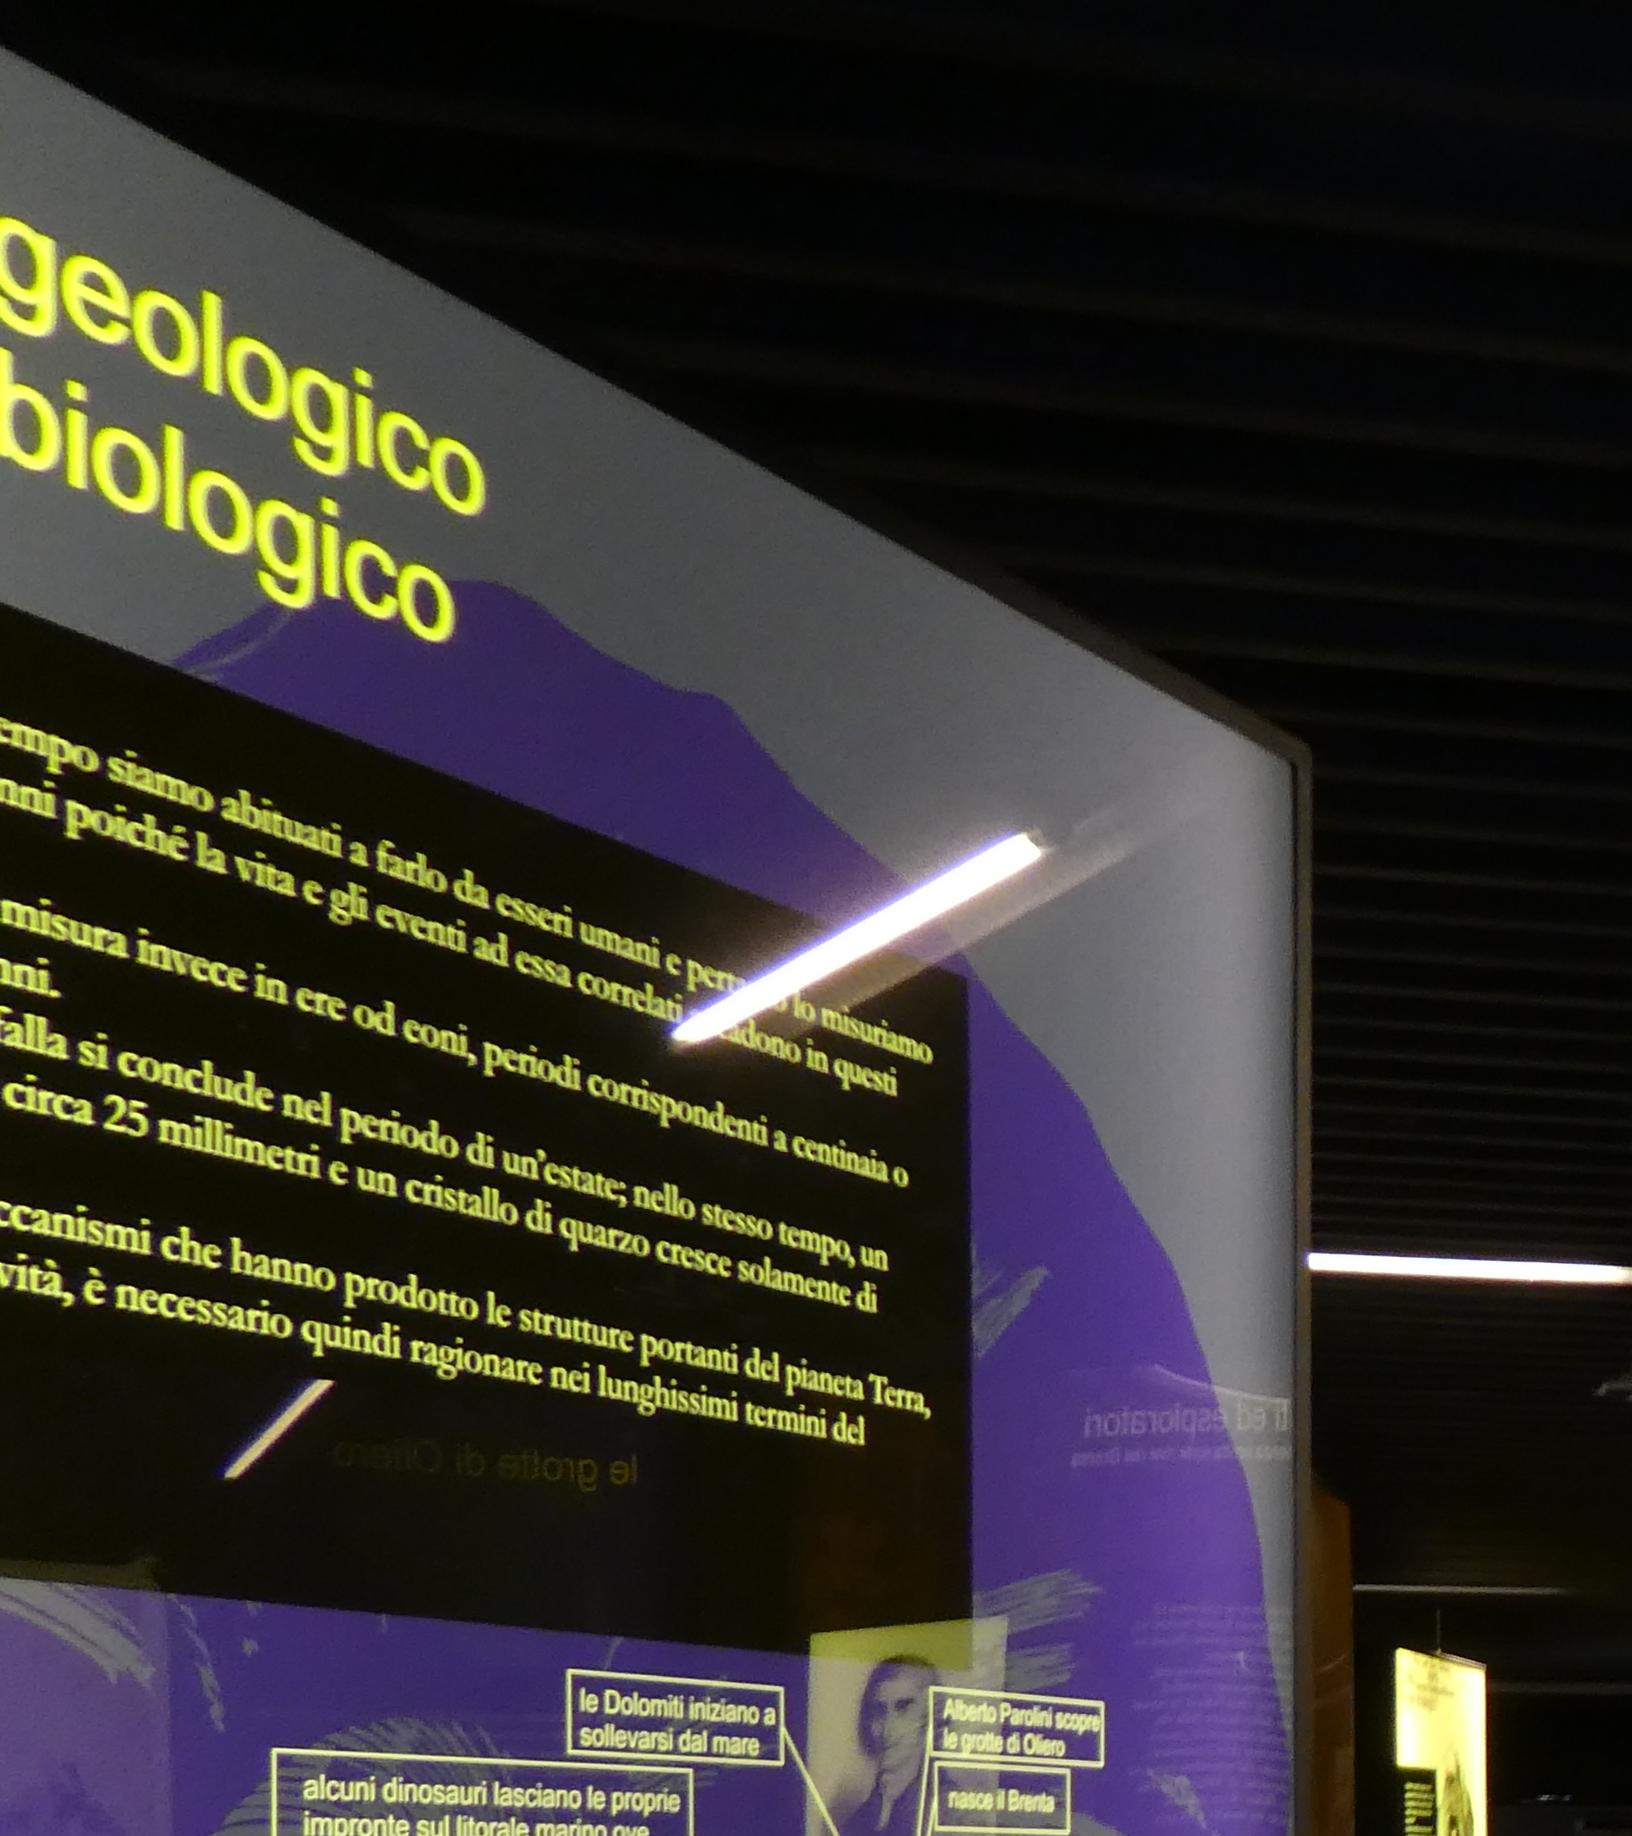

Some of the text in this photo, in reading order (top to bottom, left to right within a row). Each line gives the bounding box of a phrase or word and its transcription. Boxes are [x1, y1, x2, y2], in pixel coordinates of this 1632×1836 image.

[0, 216, 486, 516] geologico
[0, 347, 455, 643] biologico
[0, 897, 910, 1188] misura invece in ere od eoni, periodi corrispondenti a centinaia o
[77, 1032, 109, 1071] si
[116, 1051, 275, 1112] conclude
[281, 1090, 333, 1127] nel
[339, 1107, 461, 1159] periodo
[465, 1131, 495, 1169] di
[632, 1182, 697, 1220] nello
[701, 1203, 774, 1241] stesso
[778, 1221, 857, 1269] tempo,
[859, 1245, 889, 1272] un
[114, 1284, 294, 1339] necessario
[299, 1314, 402, 1360] quindi
[409, 1336, 544, 1386] ragionare
[549, 1361, 591, 1395] nei
[597, 1364, 739, 1422] lunghissimi
[744, 1401, 828, 1439] termini
[830, 1411, 866, 1446] del
[159, 1225, 932, 1420] che hanno prodotto le strutture portanti del pianeta Terra,
[579, 1687, 776, 1726] le Dolomiti iniziano a
[579, 1722, 760, 1758] sollevarsi dal mare
[943, 1698, 1101, 1735] Alberto Parolini scopre
[943, 1727, 1066, 1757] le grotte di Oliero
[303, 1774, 681, 1817] alcuni dinosauri lasciano le proprie
[947, 1790, 994, 1811] nasce
[1008, 1789, 1056, 1813] Brenta
